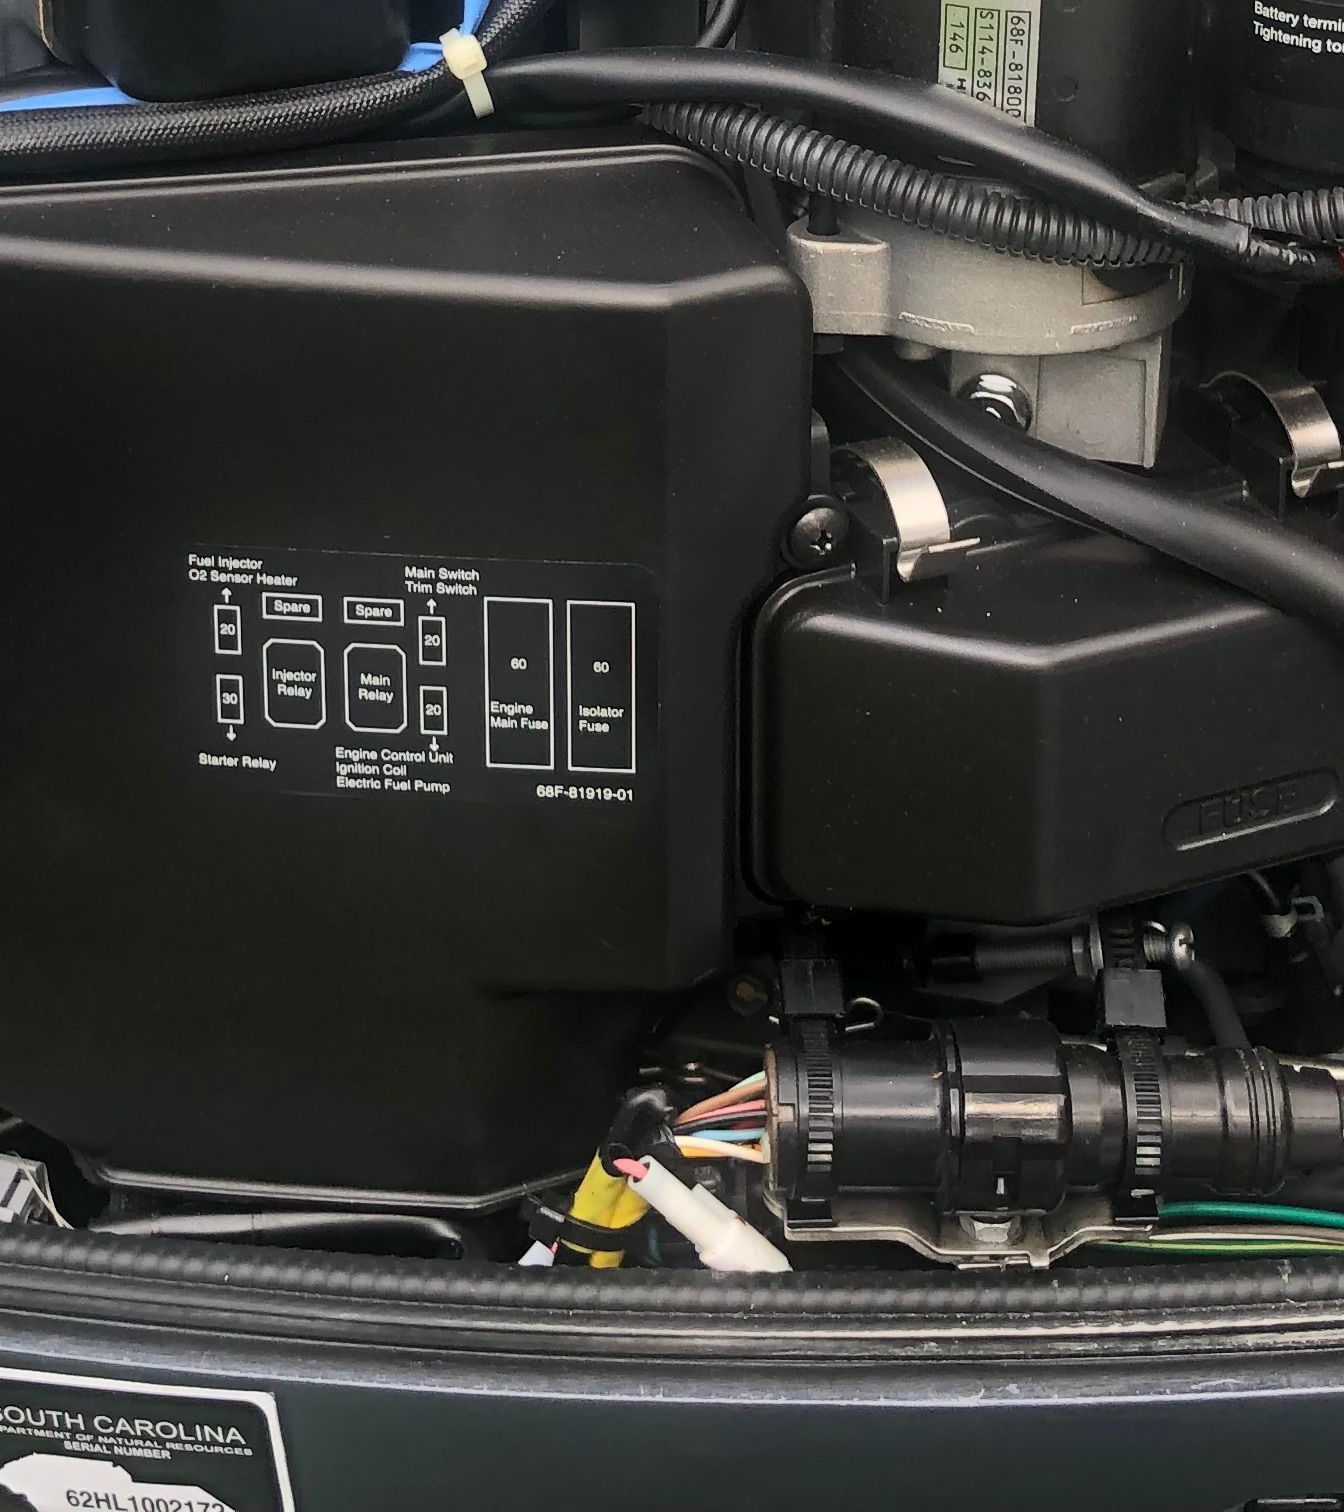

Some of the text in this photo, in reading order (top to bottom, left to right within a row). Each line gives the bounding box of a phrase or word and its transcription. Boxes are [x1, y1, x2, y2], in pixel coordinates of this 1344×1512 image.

[1254, 1, 1299, 28] Battery
[949, 21, 965, 54] 146
[1253, 20, 1322, 53] Tightening
[189, 554, 263, 572] Fuel Injector
[189, 569, 297, 586] O2 Sensor Heater
[405, 566, 479, 581] Main Switch
[405, 581, 477, 595] Trim Switch
[274, 600, 310, 614] Spare
[356, 604, 392, 618] Spare
[220, 623, 235, 635] 20
[425, 635, 440, 646] 20
[511, 658, 527, 669] 60
[593, 662, 609, 673] 60
[272, 668, 316, 685] Injector
[360, 673, 390, 686] Main
[223, 693, 238, 704] 30
[277, 683, 312, 699] Relay
[359, 688, 393, 703] Relay
[426, 704, 441, 715] 20
[491, 701, 533, 716] Engine
[579, 705, 624, 718] Isolator
[491, 716, 548, 730] Main Fuse
[579, 720, 609, 732] Fuse
[199, 753, 276, 771] Starter Relay
[336, 747, 453, 764] Engine Control Unit
[336, 762, 407, 778] Ignition Coil
[337, 776, 450, 794] Electric Fuel Pump
[537, 785, 632, 801] 68F-81919-01
[93, 1415, 247, 1445] CAROLINA
[64, 1440, 172, 1460] SERIAL NUMBER
[75, 1433, 94, 1442] OF
[97, 1436, 164, 1449] NATURAL
[165, 1441, 254, 1457] RESOURCES
